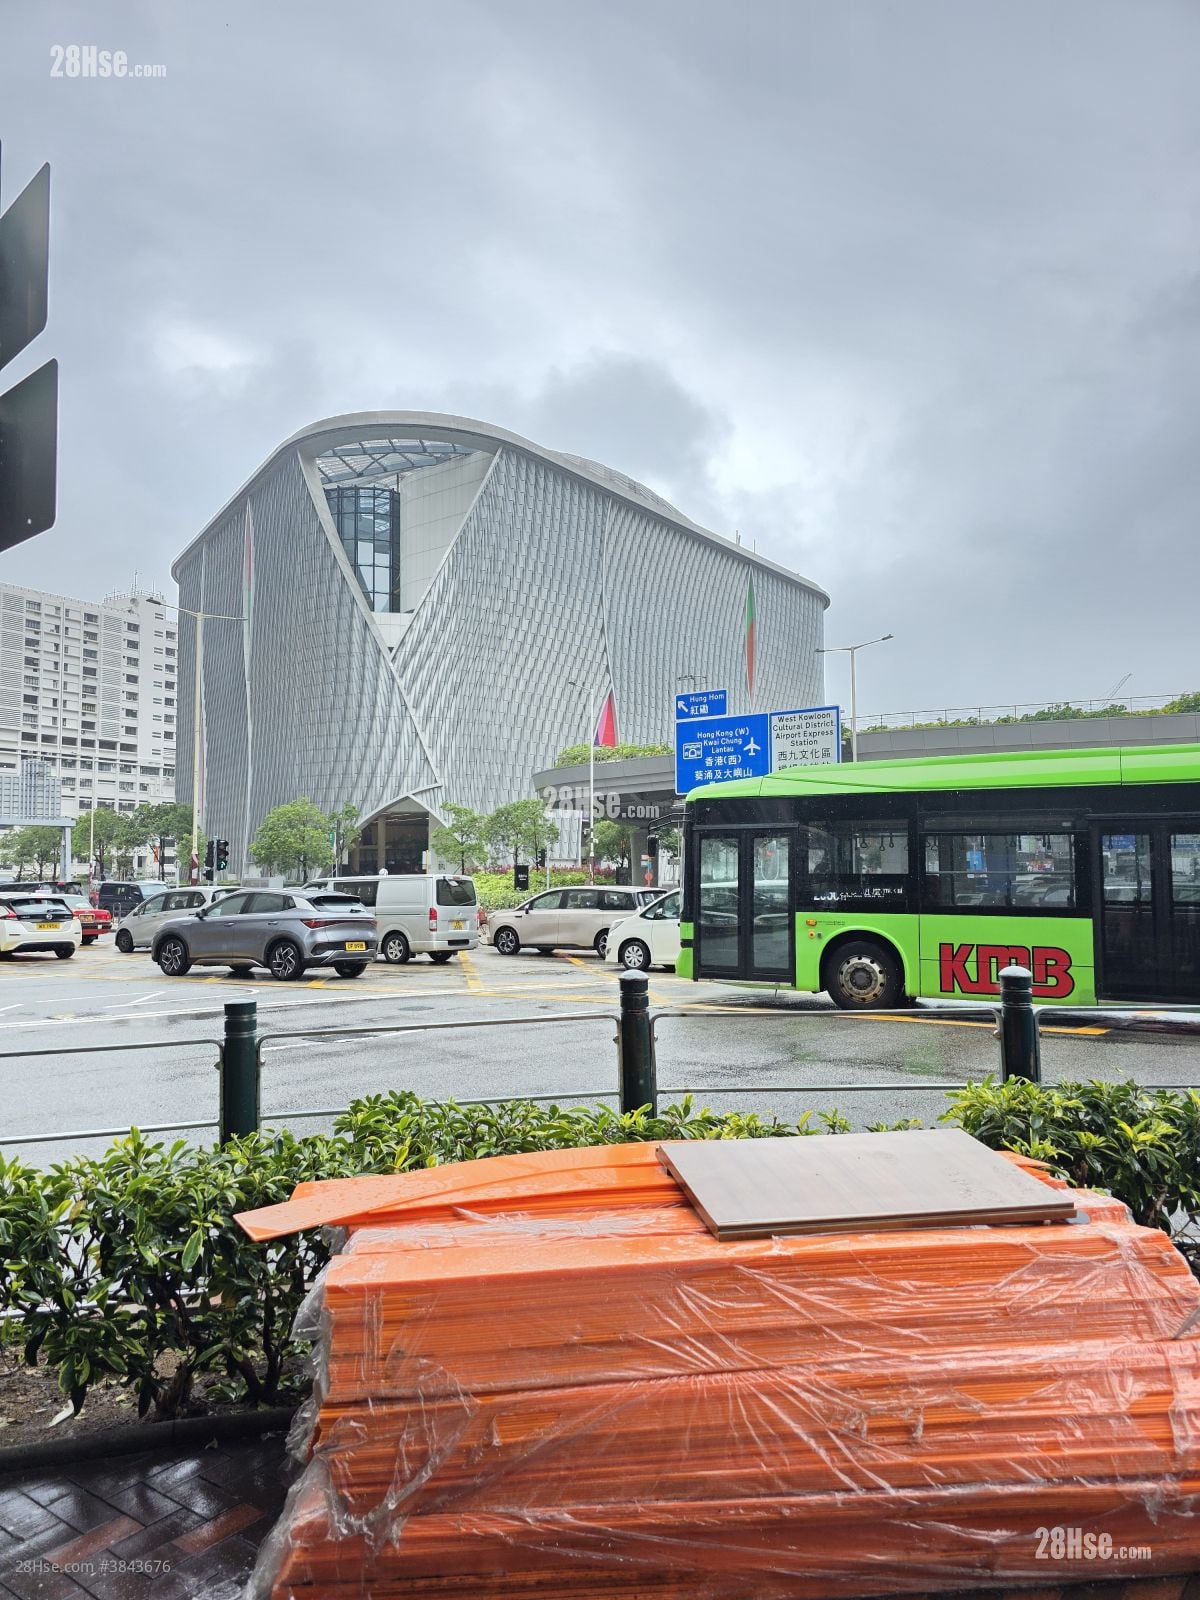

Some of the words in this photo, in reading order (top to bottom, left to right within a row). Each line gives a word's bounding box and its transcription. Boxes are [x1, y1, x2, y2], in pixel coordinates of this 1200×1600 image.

[689, 695, 707, 703] Hung
[708, 693, 725, 701] Hom
[777, 715, 797, 723] West
[798, 712, 831, 721] Kowloon
[772, 723, 803, 732] Cultural
[805, 719, 835, 729] District
[697, 731, 715, 739] Hong
[715, 729, 734, 738] Kong
[734, 726, 749, 737] (W)
[775, 731, 801, 740] Airport
[803, 729, 834, 739] Express
[703, 738, 720, 746] Kwai
[720, 737, 742, 745] Chung
[790, 738, 818, 747] Station
[711, 745, 734, 754] Lantau
[777, 747, 831, 761] 西九文化區
[704, 754, 742, 767] 香港(西)
[694, 767, 753, 781] 葵涌及大嶼山
[938, 942, 1075, 999] KMB
